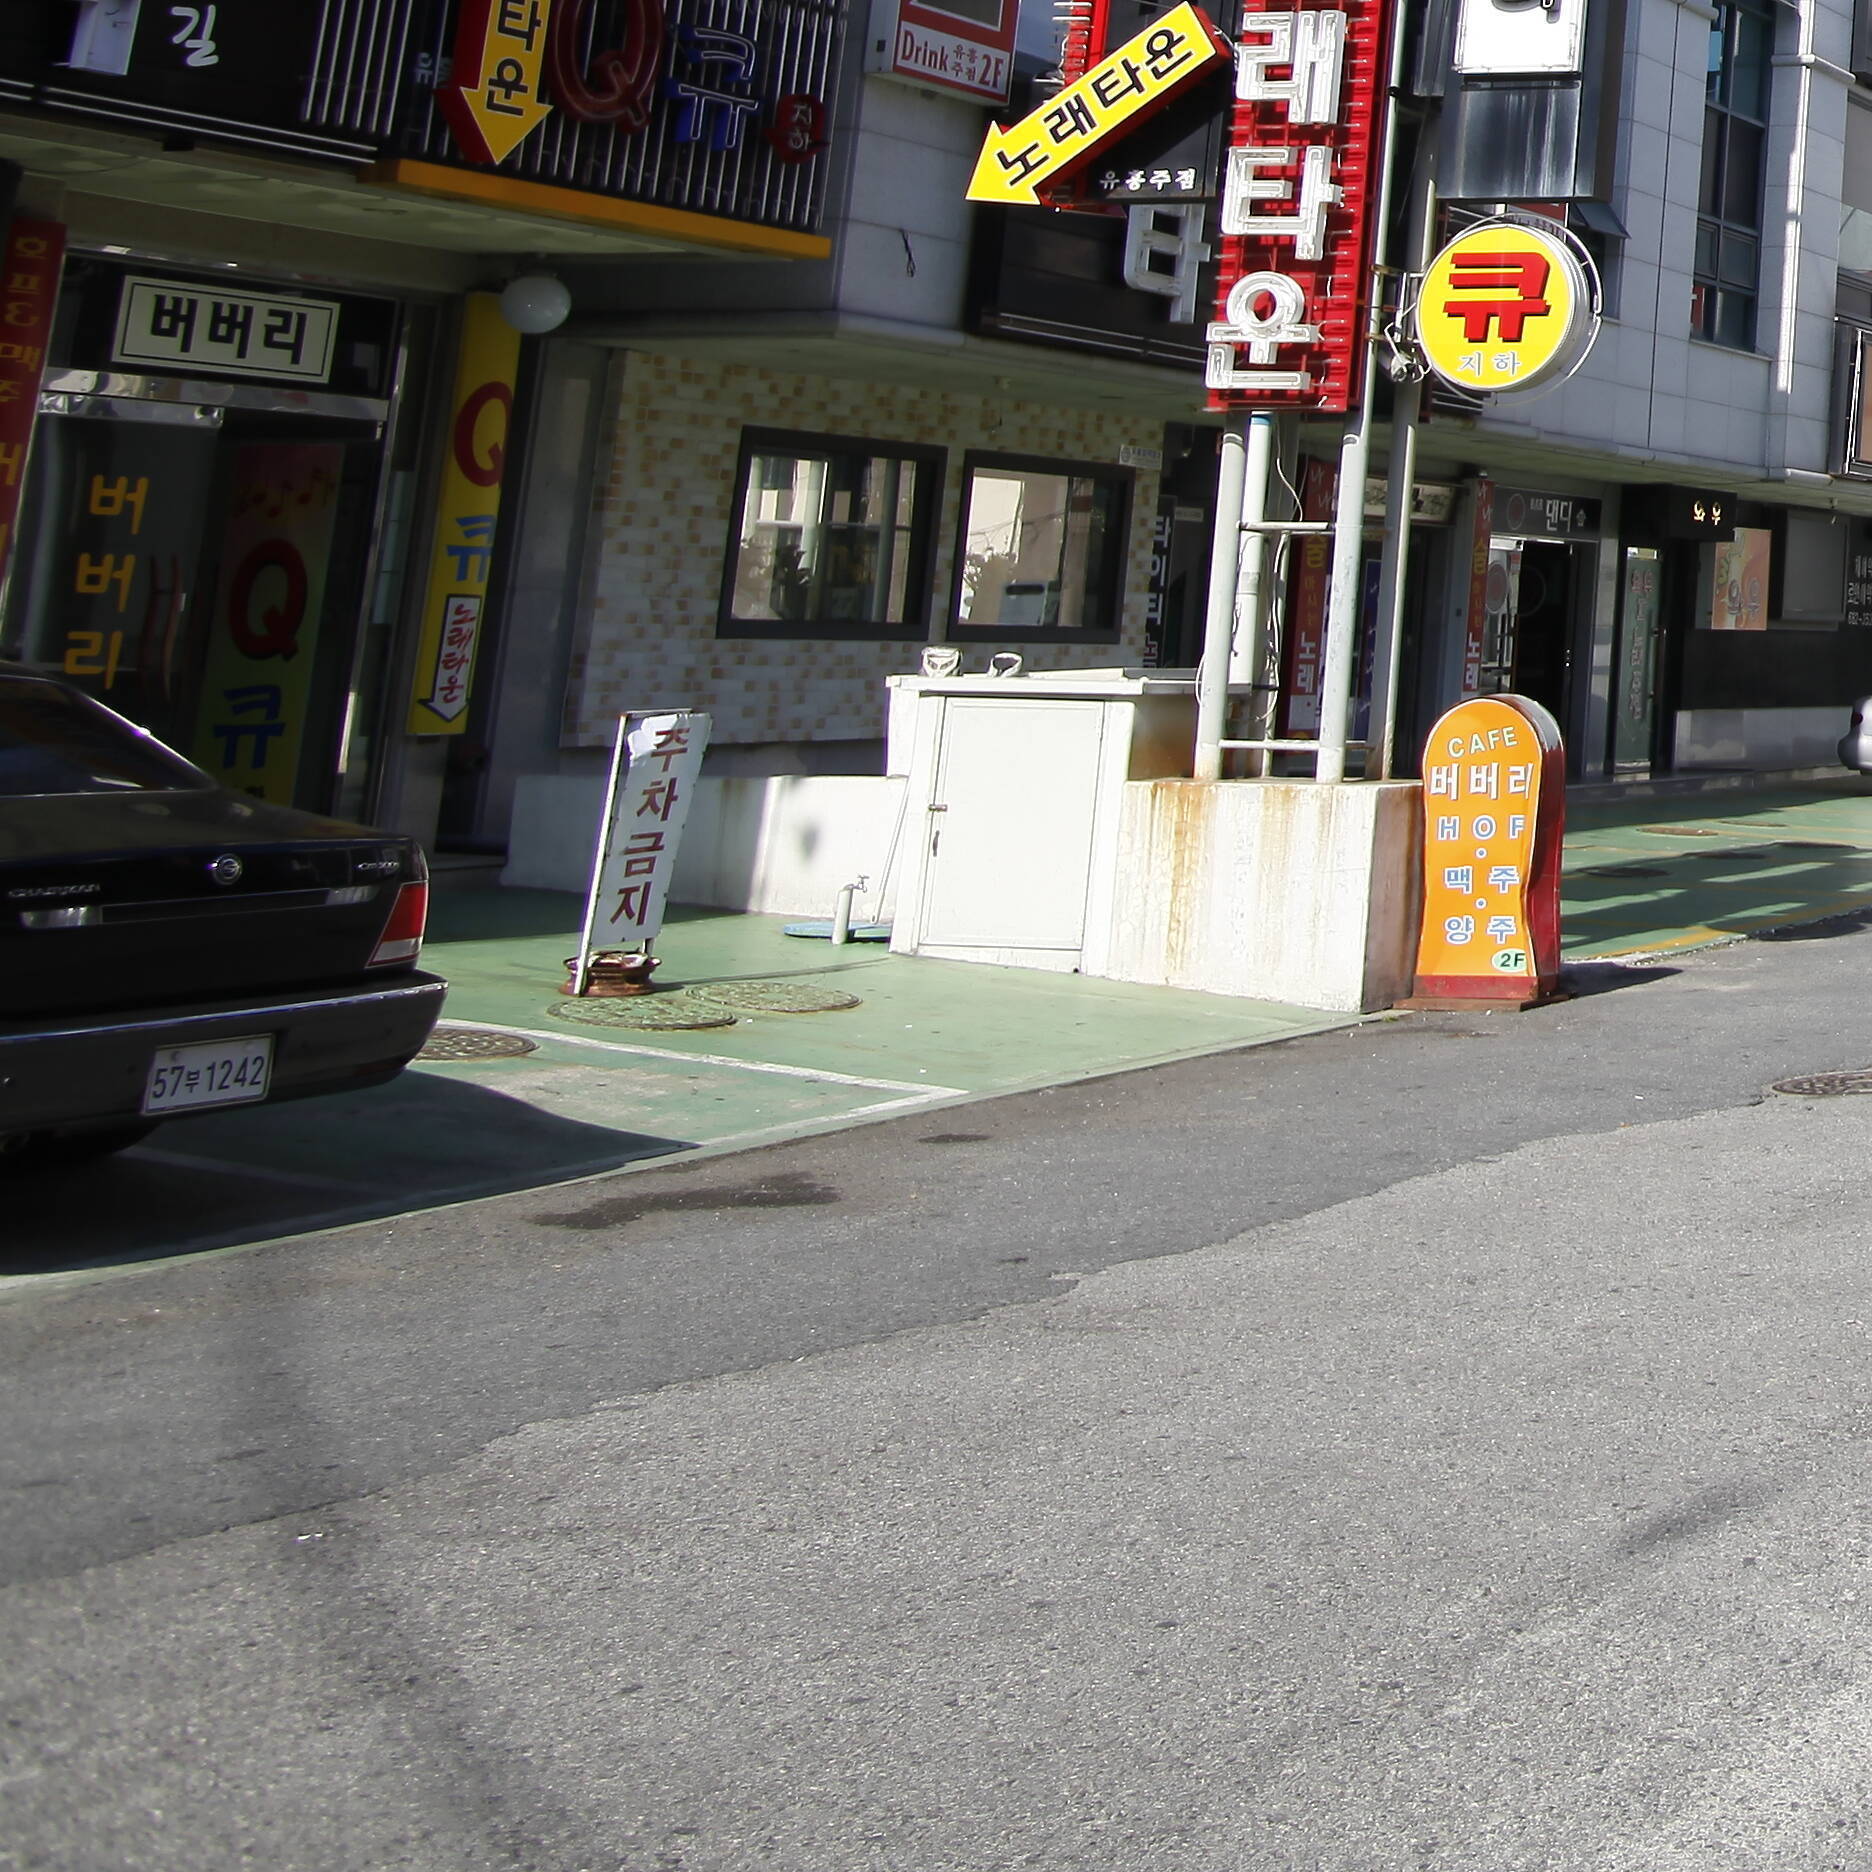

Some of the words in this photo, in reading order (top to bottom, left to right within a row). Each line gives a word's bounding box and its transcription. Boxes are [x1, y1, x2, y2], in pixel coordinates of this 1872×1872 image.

[900, 28, 950, 74] Drink
[665, 21, 761, 151] 큐
[995, 27, 1197, 186] 노래타운
[1099, 167, 1197, 192] 유흥주점
[150, 293, 308, 365] 버버리
[1441, 249, 1552, 345] 큐
[1456, 350, 1523, 379] 지하
[445, 514, 494, 583] 큐
[1545, 499, 1574, 533] 댄디
[64, 474, 151, 691] 버버리
[228, 538, 310, 662] Q
[437, 602, 479, 706] 노래타운
[212, 685, 285, 770] 큐
[1448, 726, 1519, 758] CAFE
[1428, 762, 1535, 800] 버버리
[610, 725, 693, 931] 주차금지
[1444, 865, 1520, 895] 맥주
[1444, 914, 1517, 945] 양주
[1500, 951, 1526, 969] 2F
